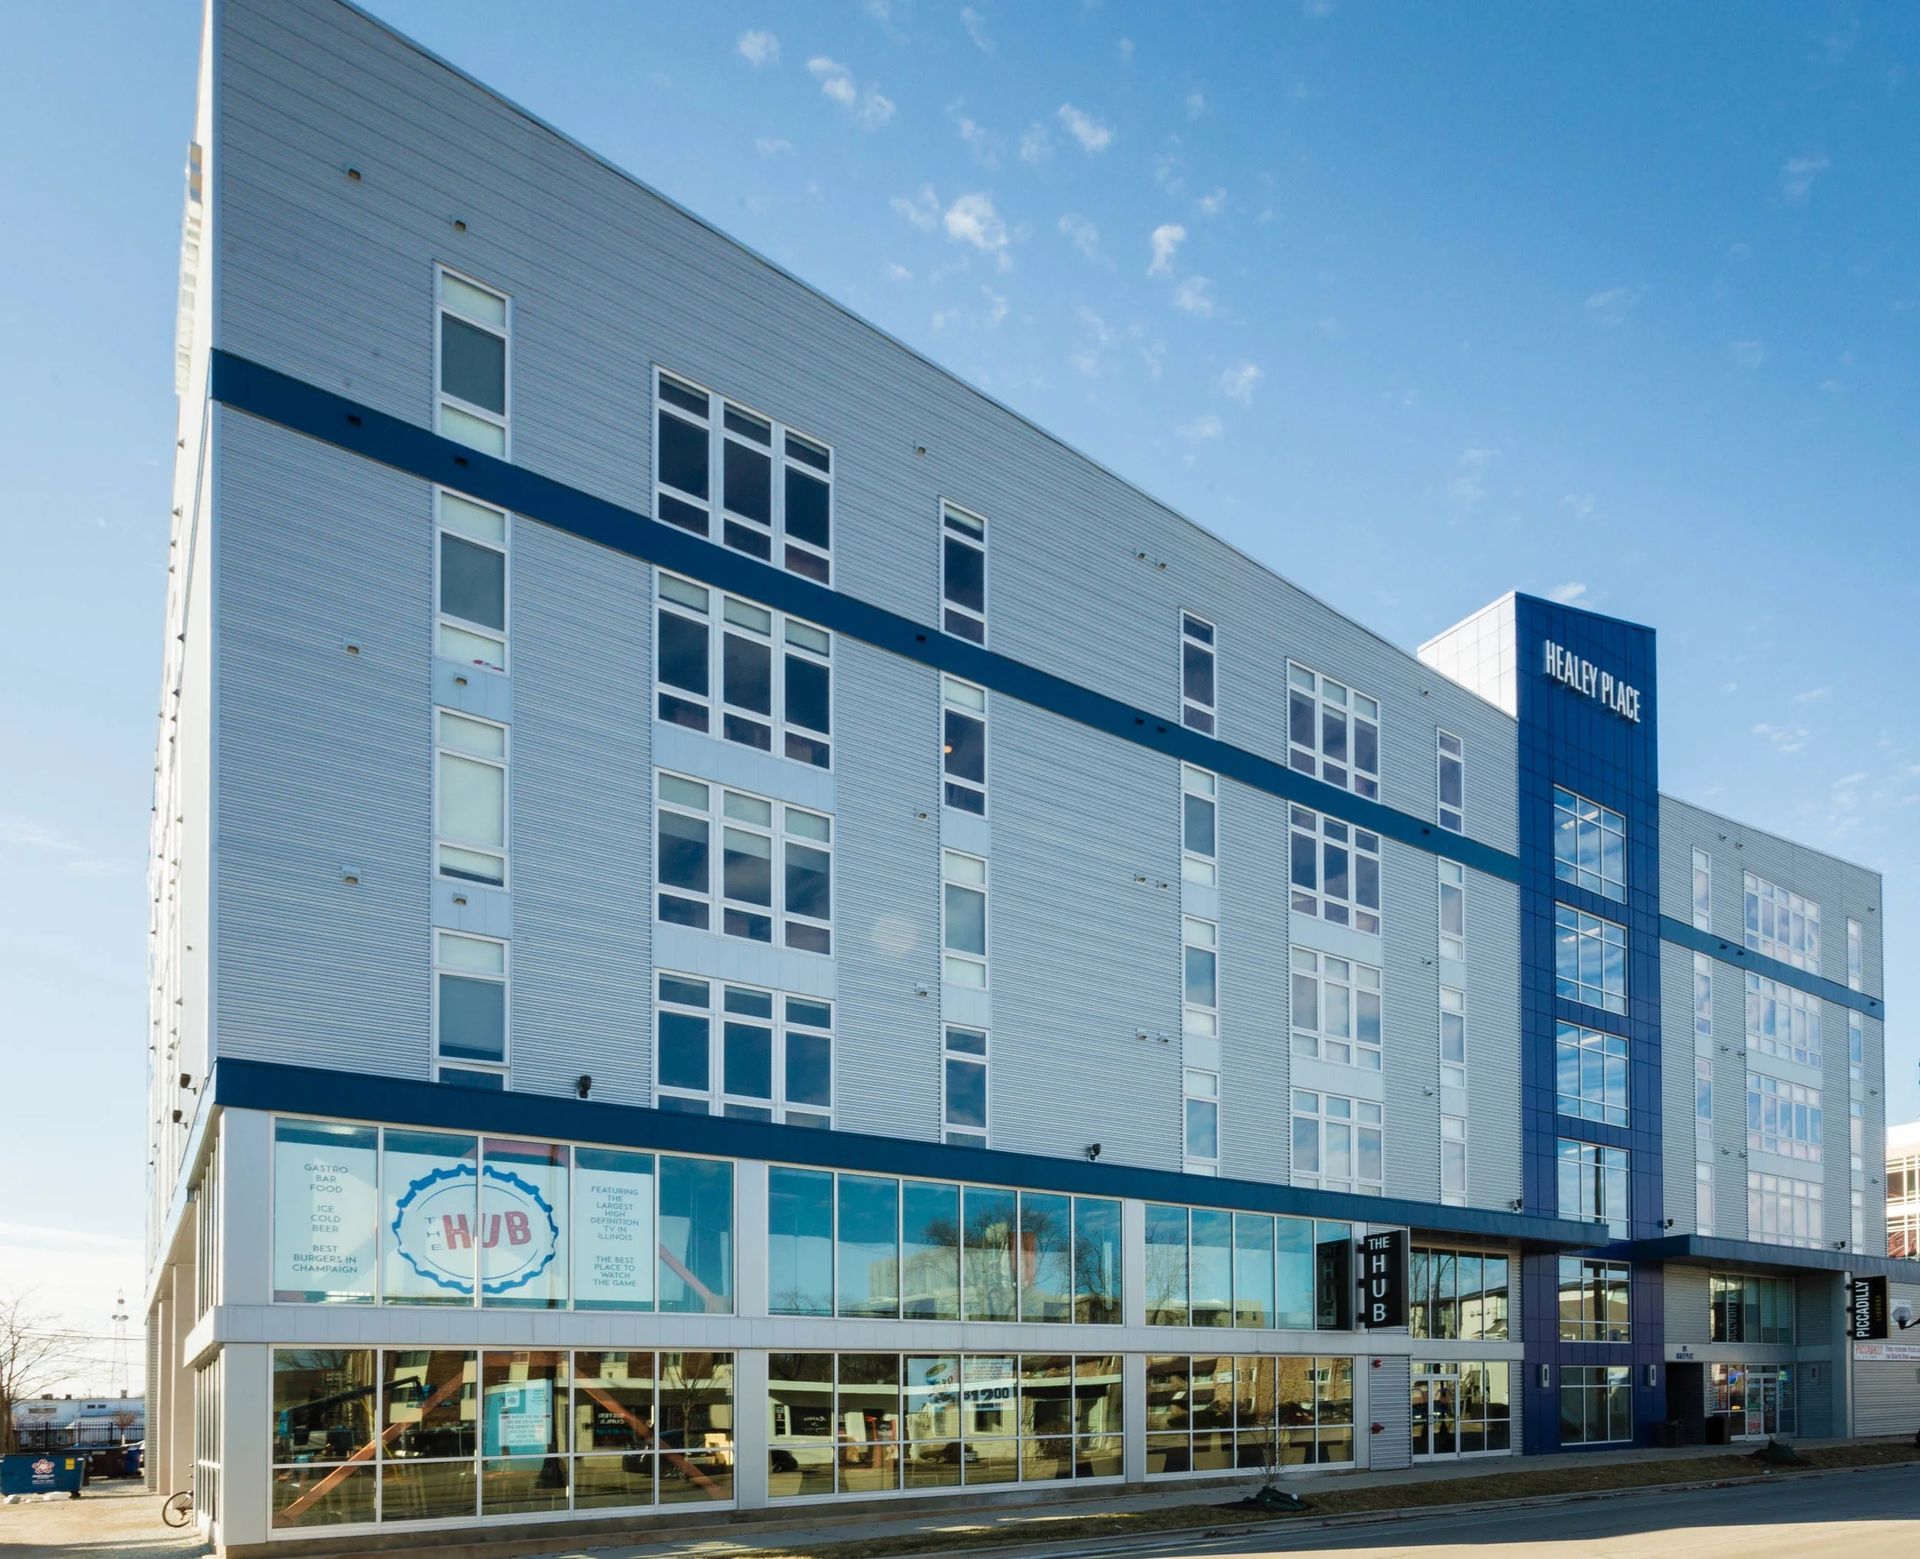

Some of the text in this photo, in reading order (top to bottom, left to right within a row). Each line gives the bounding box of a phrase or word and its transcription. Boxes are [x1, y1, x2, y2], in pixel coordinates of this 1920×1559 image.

[1545, 639, 1641, 723] HEALEY PLACE
[303, 1163, 349, 1174] GASTRO
[315, 1174, 337, 1183] BAR
[309, 1184, 343, 1193] FOOD
[591, 1186, 639, 1196] FEATURING
[317, 1204, 335, 1213] ICE
[596, 1202, 633, 1211] LARGEST
[310, 1214, 341, 1223] COLD
[604, 1210, 626, 1218] HIGH
[590, 1217, 640, 1226] DEFINITION
[312, 1224, 339, 1233] BEER
[442, 1211, 532, 1250] HUB
[597, 1232, 633, 1241] ILLINOIS
[1367, 1236, 1392, 1251] THE
[312, 1245, 338, 1253] BEST
[293, 1254, 357, 1264] BURGERS IN
[596, 1255, 635, 1264] THE BEST
[292, 1263, 358, 1274] CHAMPAIGN
[594, 1263, 636, 1272] PLACE TO
[600, 1271, 630, 1279] WATCH
[593, 1278, 636, 1287] THE GAME
[1372, 1254, 1387, 1322] HUB
[1855, 1281, 1870, 1337] PICCADILLY
